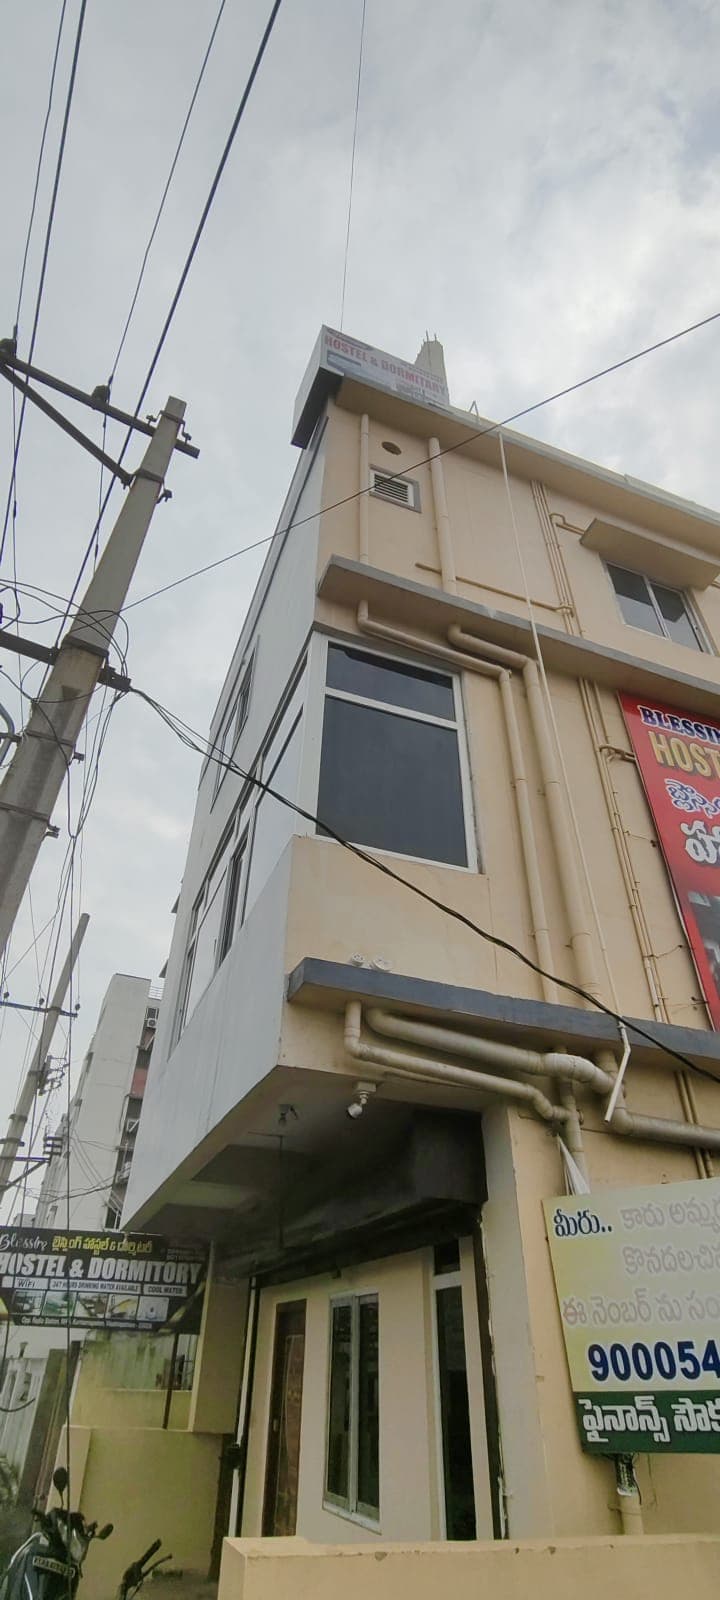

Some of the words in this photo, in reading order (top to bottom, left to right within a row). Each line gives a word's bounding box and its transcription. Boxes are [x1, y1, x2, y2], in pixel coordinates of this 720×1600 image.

[325, 335, 368, 362] HOSTEL
[621, 1202, 665, 1229] కారు
[0, 1251, 67, 1276] HOSTEL
[69, 1258, 84, 1278] &
[87, 1256, 202, 1284] DORMITORY
[563, 1297, 587, 1325] ఈ
[591, 1287, 651, 1325] నెంబర్
[655, 1293, 682, 1322] ను
[588, 1339, 720, 1382] 900054
